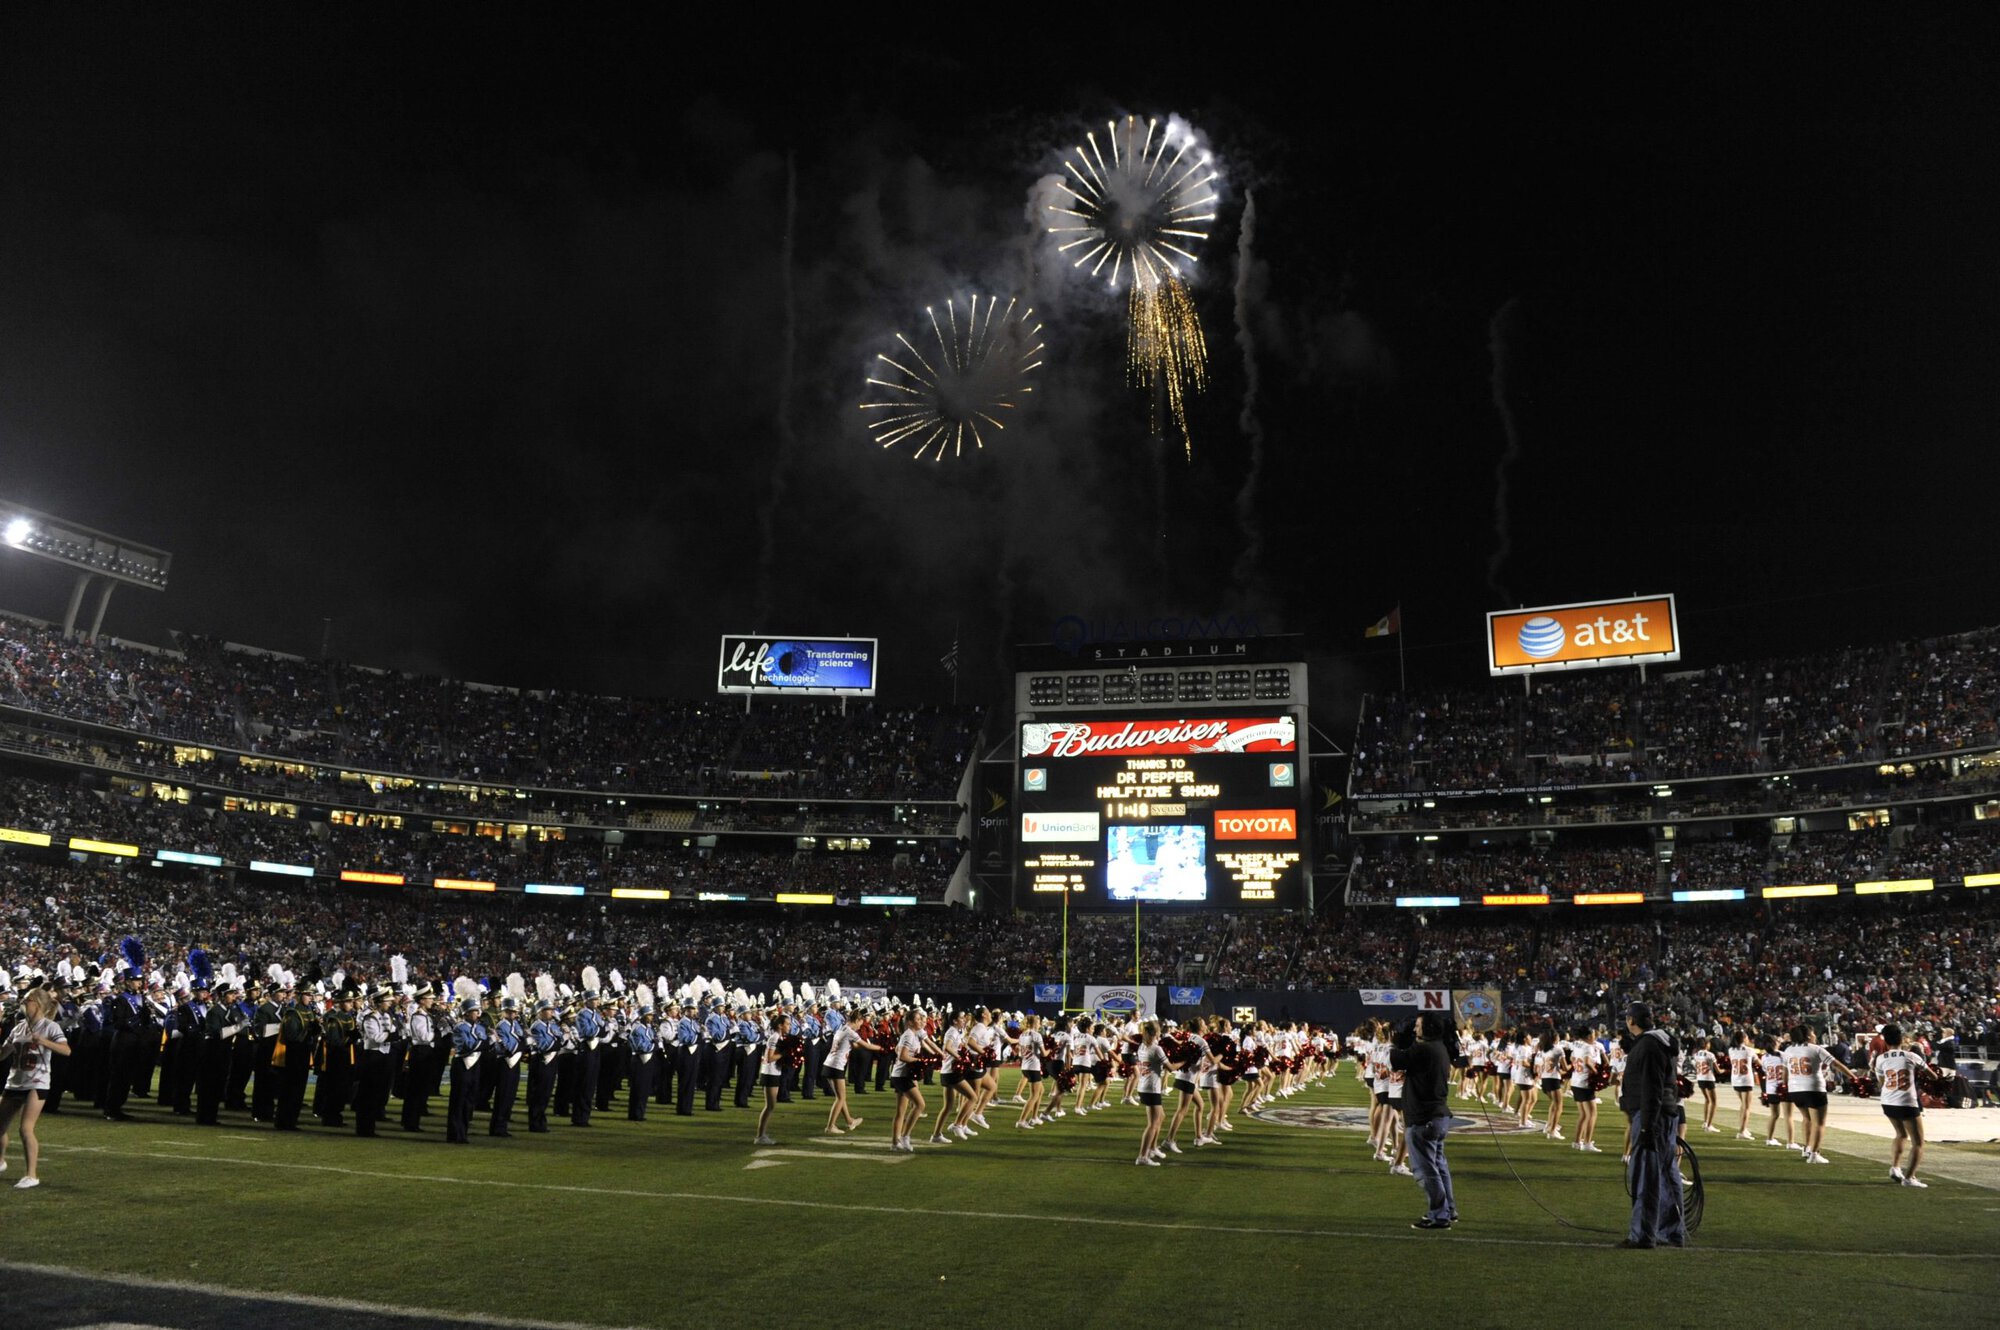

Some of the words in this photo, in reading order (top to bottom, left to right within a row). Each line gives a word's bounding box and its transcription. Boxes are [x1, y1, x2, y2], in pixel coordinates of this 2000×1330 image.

[1573, 612, 1650, 647] at&t
[806, 650, 868, 661] Transforming
[1095, 644, 1246, 658] STADIUM
[723, 641, 775, 685] life
[819, 659, 854, 667] science
[759, 674, 816, 683] technologies
[1047, 719, 1229, 757] Budweiser
[1126, 759, 1167, 770] THANKS
[1170, 758, 1186, 769] TO
[1116, 772, 1137, 784] DR
[1141, 771, 1195, 784] PEPPER
[1096, 786, 1172, 798] HALFTIME
[1180, 784, 1220, 797] SHOW
[1151, 805, 1186, 815] SYCUAN
[980, 816, 1009, 829] Sprint
[1217, 817, 1293, 833] TOYOTA
[1314, 813, 1346, 825] Sprint
[1041, 822, 1097, 833] UnionBank
[1276, 853, 1300, 861] LIFE
[1484, 895, 1516, 904] WELLS
[1516, 895, 1548, 903] FARGO
[1101, 991, 1125, 1001] PACIFIC
[1424, 992, 1443, 1009] N
[1235, 1007, 1254, 1022] 25
